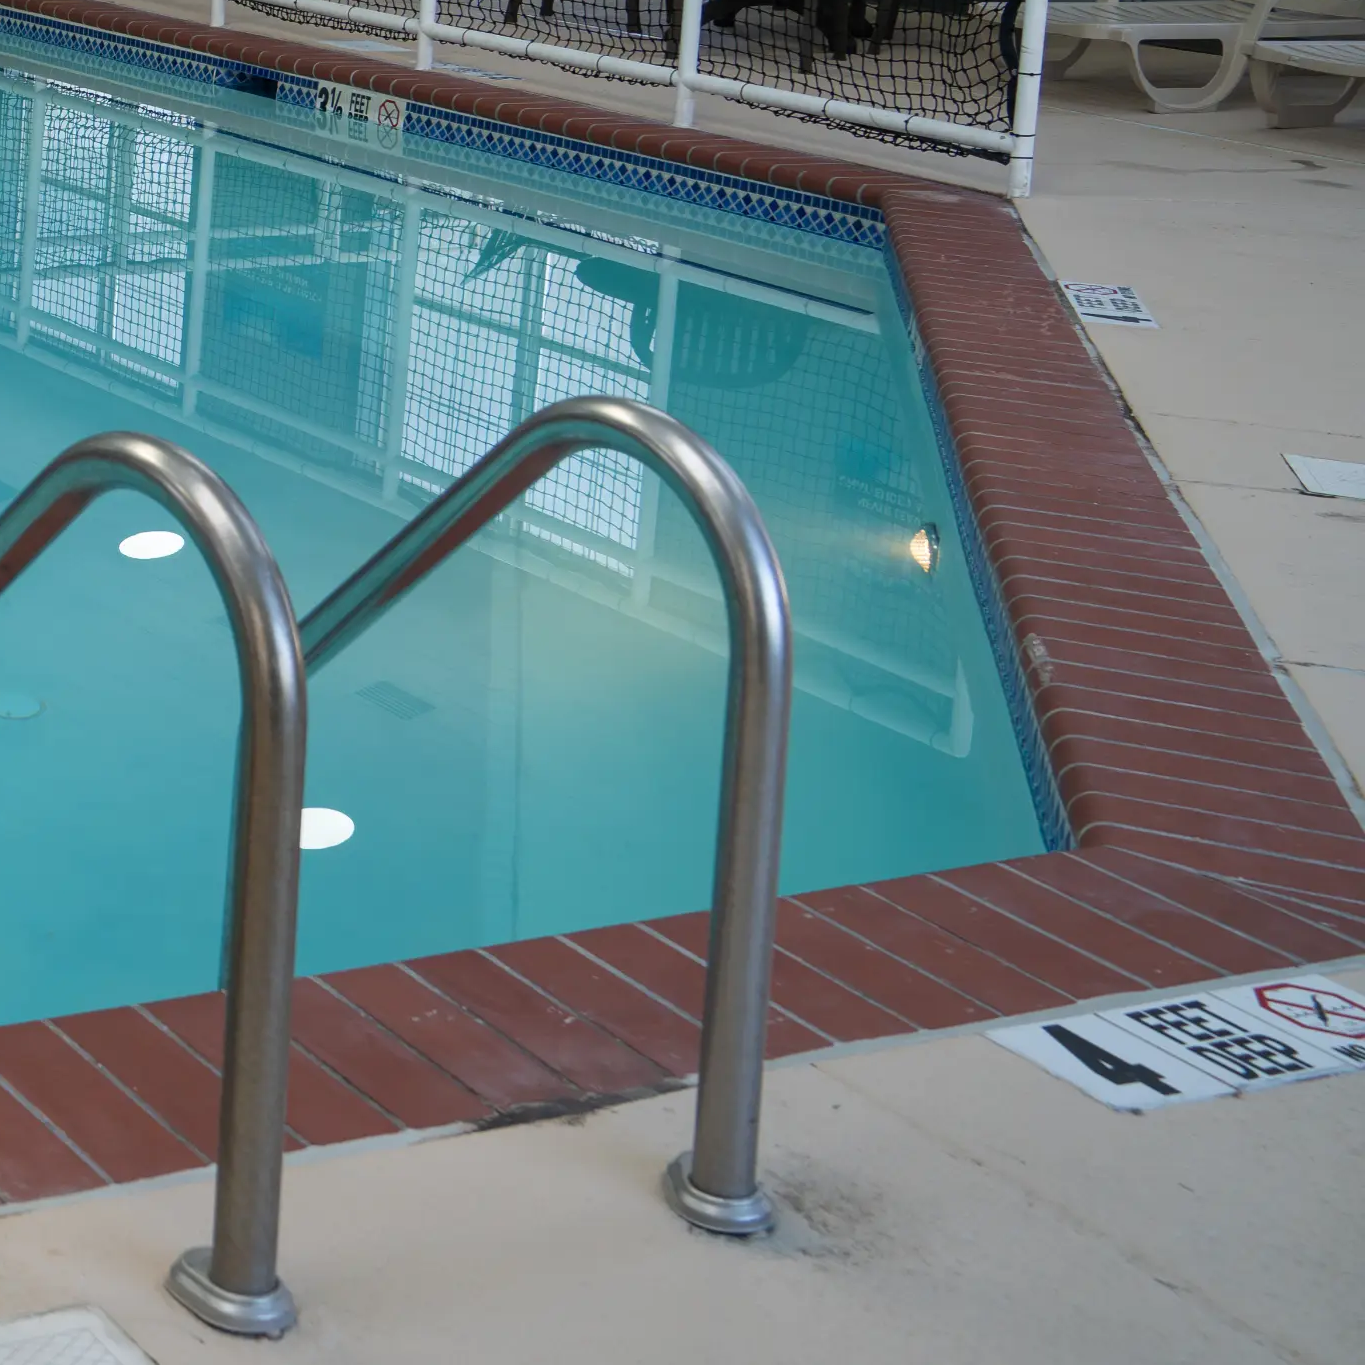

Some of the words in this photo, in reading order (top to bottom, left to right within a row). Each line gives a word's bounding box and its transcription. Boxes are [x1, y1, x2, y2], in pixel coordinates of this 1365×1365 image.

[349, 92, 372, 115] FEET
[1073, 294, 1108, 309] FEET
[1080, 312, 1152, 324] 4
[1124, 999, 1250, 1046] FEET
[1041, 1024, 1182, 1096] 4
[1187, 1033, 1315, 1080] DEEP
